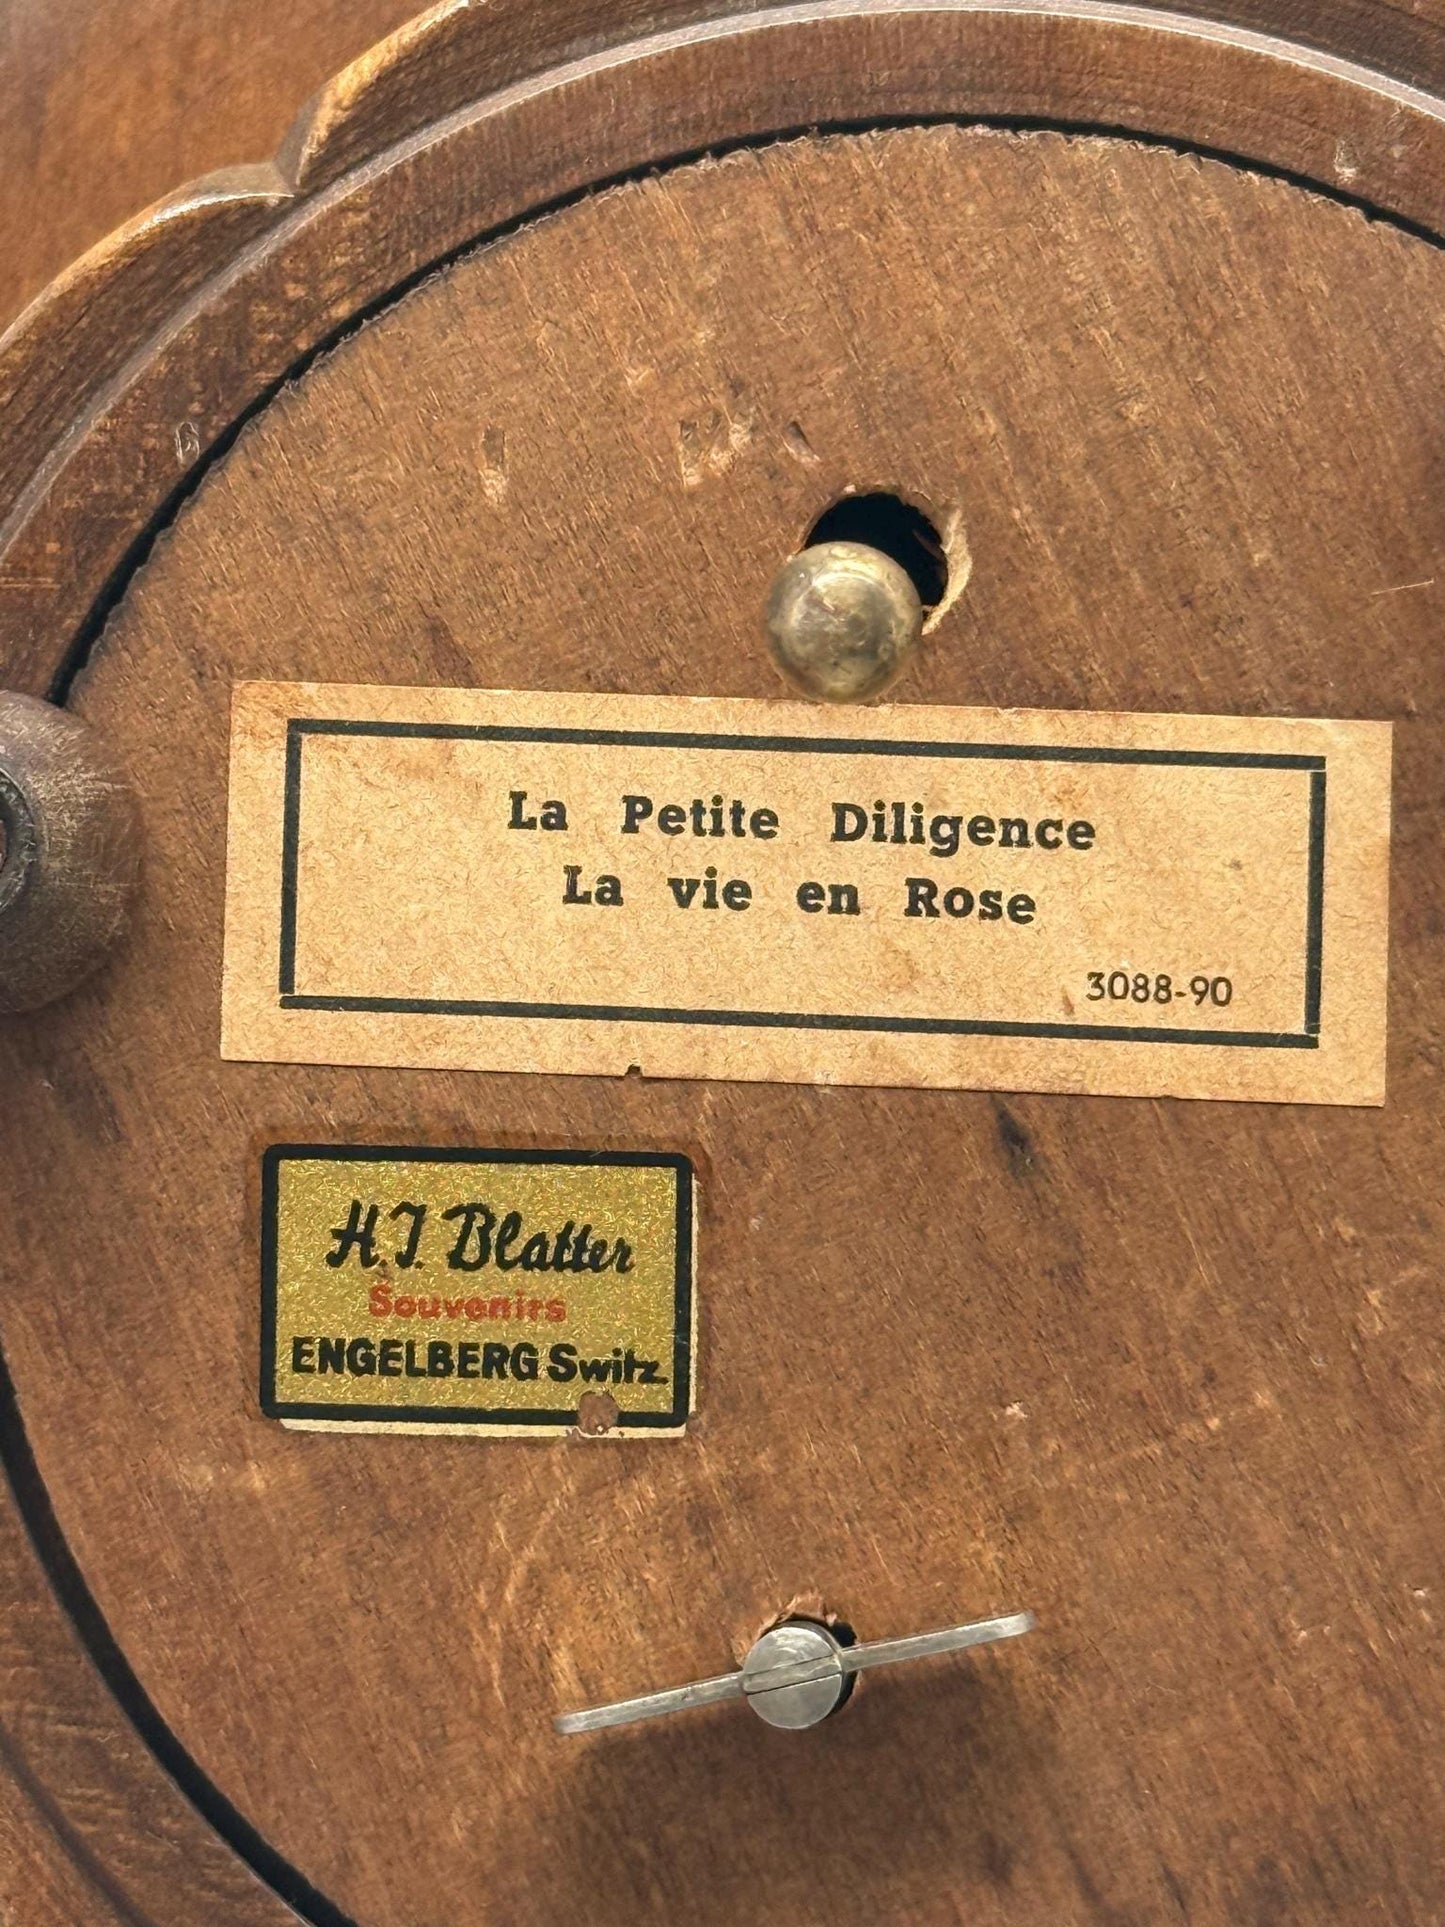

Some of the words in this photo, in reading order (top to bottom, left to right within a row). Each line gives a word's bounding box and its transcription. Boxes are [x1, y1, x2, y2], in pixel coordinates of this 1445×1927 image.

[508, 791, 568, 830] La
[621, 795, 780, 840] Petite
[830, 800, 1096, 858] Diligence
[562, 864, 624, 906] La
[667, 866, 753, 911] vie
[796, 881, 861, 915] en
[904, 876, 1037, 924] Rose
[1085, 971, 1233, 1007] 3088-90
[442, 1202, 635, 1274] Blatter
[368, 1281, 567, 1323] Souvenirs
[292, 1336, 538, 1380] ENGELBERG
[547, 1342, 669, 1385] Switz.
